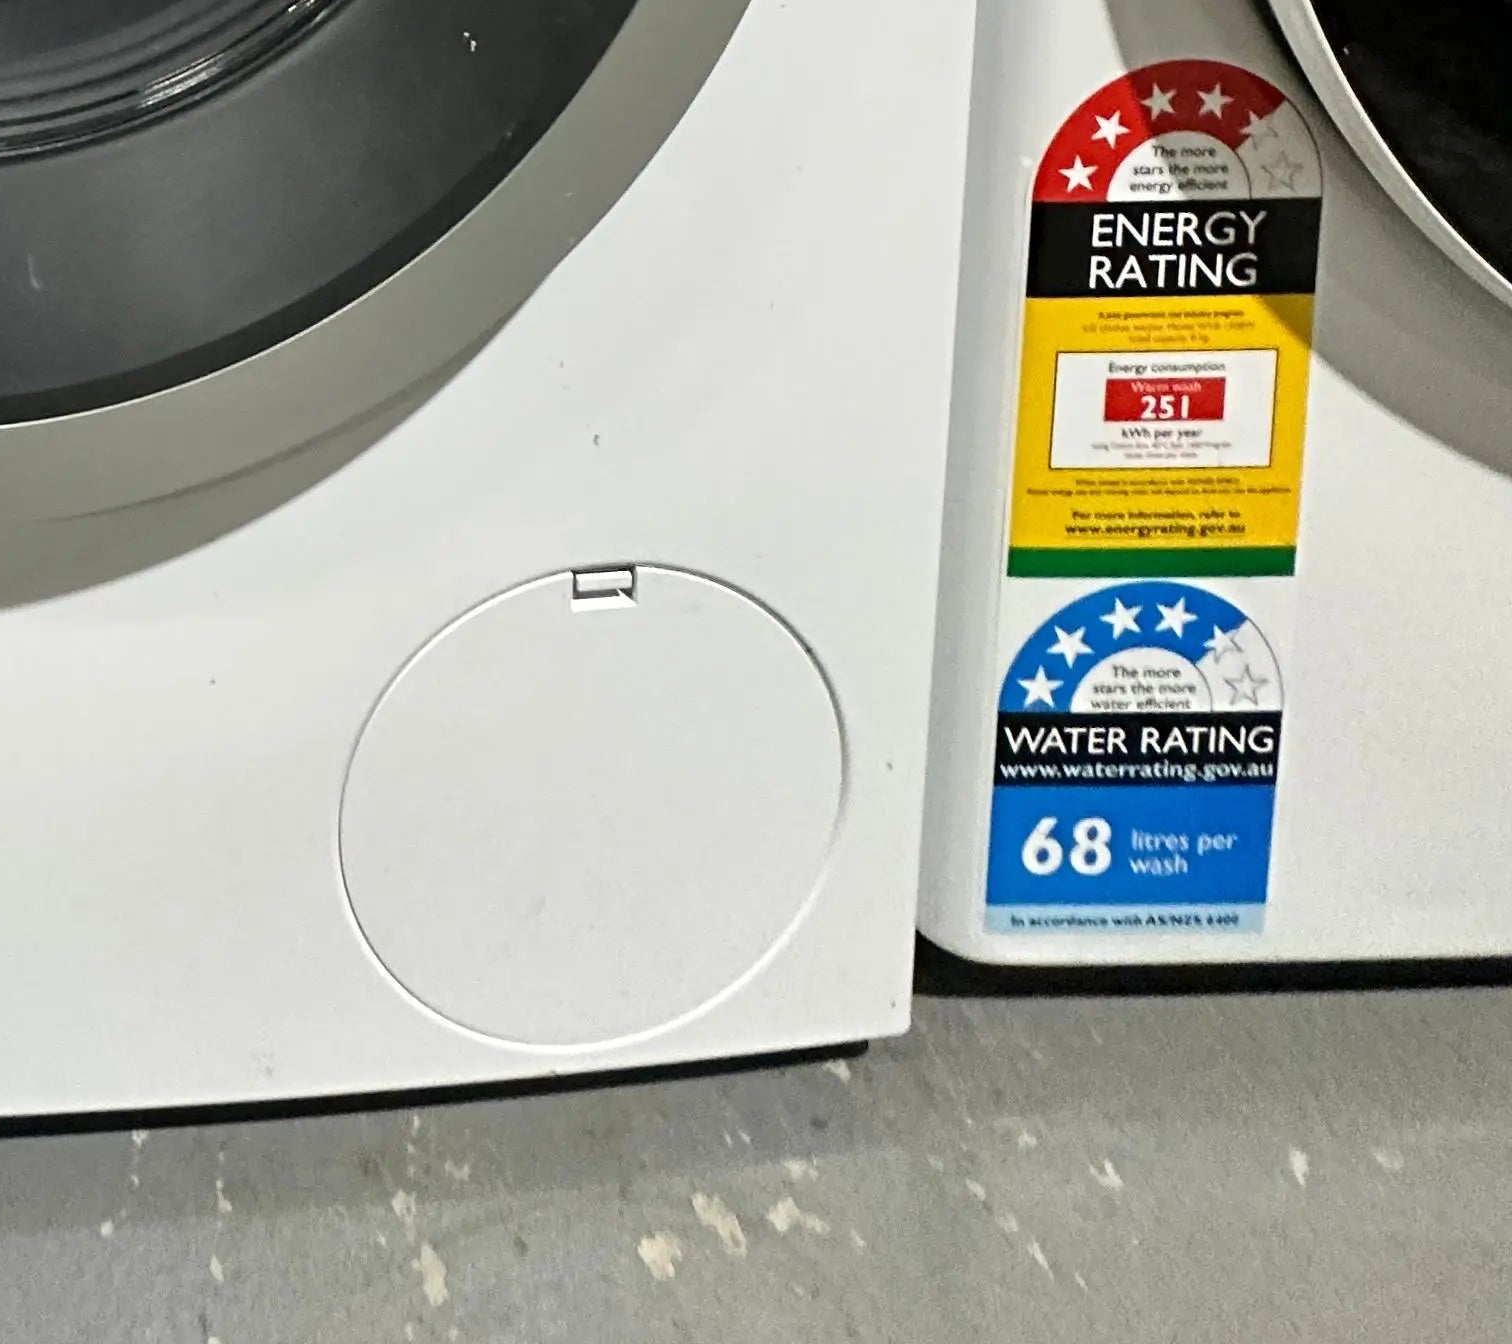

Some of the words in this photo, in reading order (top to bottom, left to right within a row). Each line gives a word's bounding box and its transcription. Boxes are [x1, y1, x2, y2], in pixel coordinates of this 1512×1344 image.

[1153, 145, 1176, 157] The
[1181, 147, 1216, 158] more
[1133, 164, 1164, 176] stars
[1169, 162, 1189, 175] the
[1130, 181, 1172, 195] energy
[1092, 210, 1268, 247] ENERGY
[1089, 251, 1258, 290] RATING
[1108, 361, 1147, 375] Energy
[1151, 361, 1226, 375] consumption
[1140, 394, 1190, 419] 251
[1121, 427, 1151, 440] kWh
[1154, 428, 1173, 442] per
[1177, 428, 1203, 442] year
[1113, 664, 1138, 678] The
[1143, 668, 1181, 678] more
[1093, 684, 1126, 694] stars
[1090, 699, 1132, 710] water
[1005, 726, 1128, 755] WATER
[1140, 725, 1274, 755] RATING
[1000, 760, 1273, 782] www.waterrating.gov.au
[1022, 816, 1113, 876] 68
[1131, 828, 1189, 851] litres
[1197, 832, 1238, 856] per
[1128, 855, 1189, 875] wash
